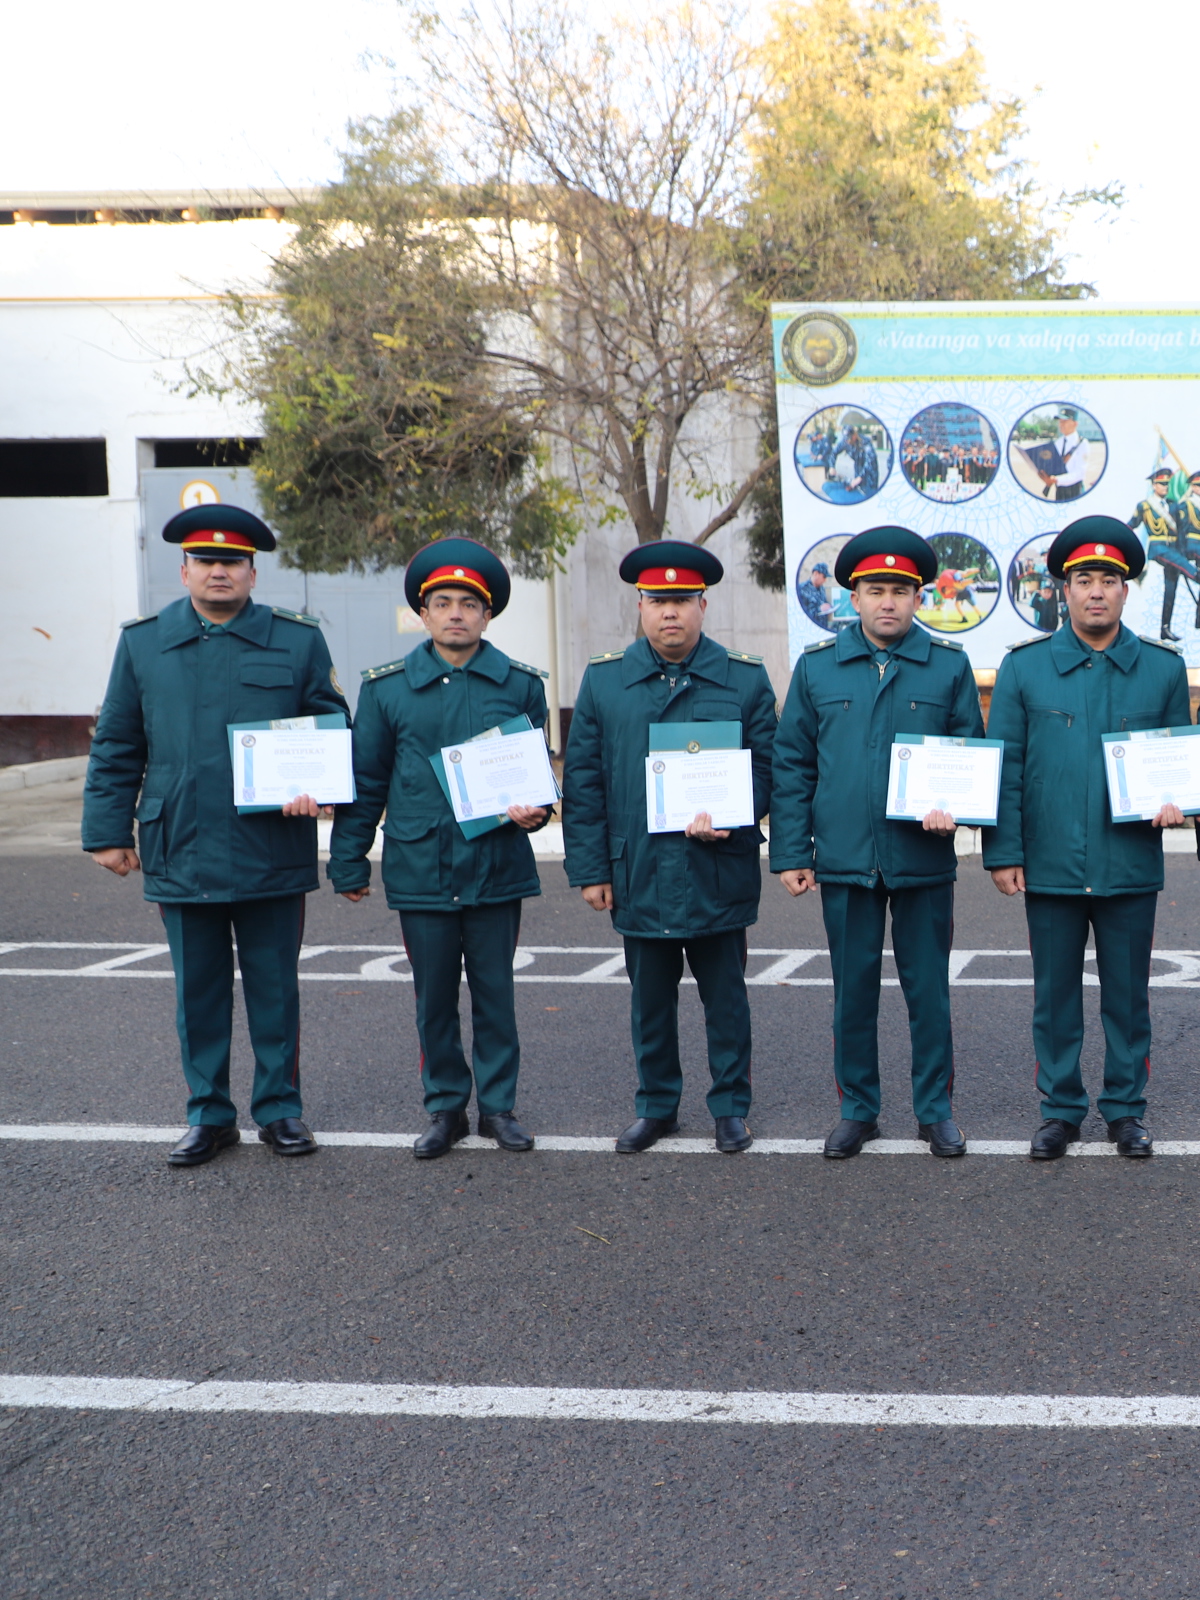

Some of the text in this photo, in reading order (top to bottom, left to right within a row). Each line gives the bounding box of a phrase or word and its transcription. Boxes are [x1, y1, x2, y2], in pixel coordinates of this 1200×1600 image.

[877, 330, 980, 353] «Vatanga
[986, 332, 1011, 348] va
[1016, 329, 1091, 352] xalqqa
[1094, 328, 1185, 352] sadoqat
